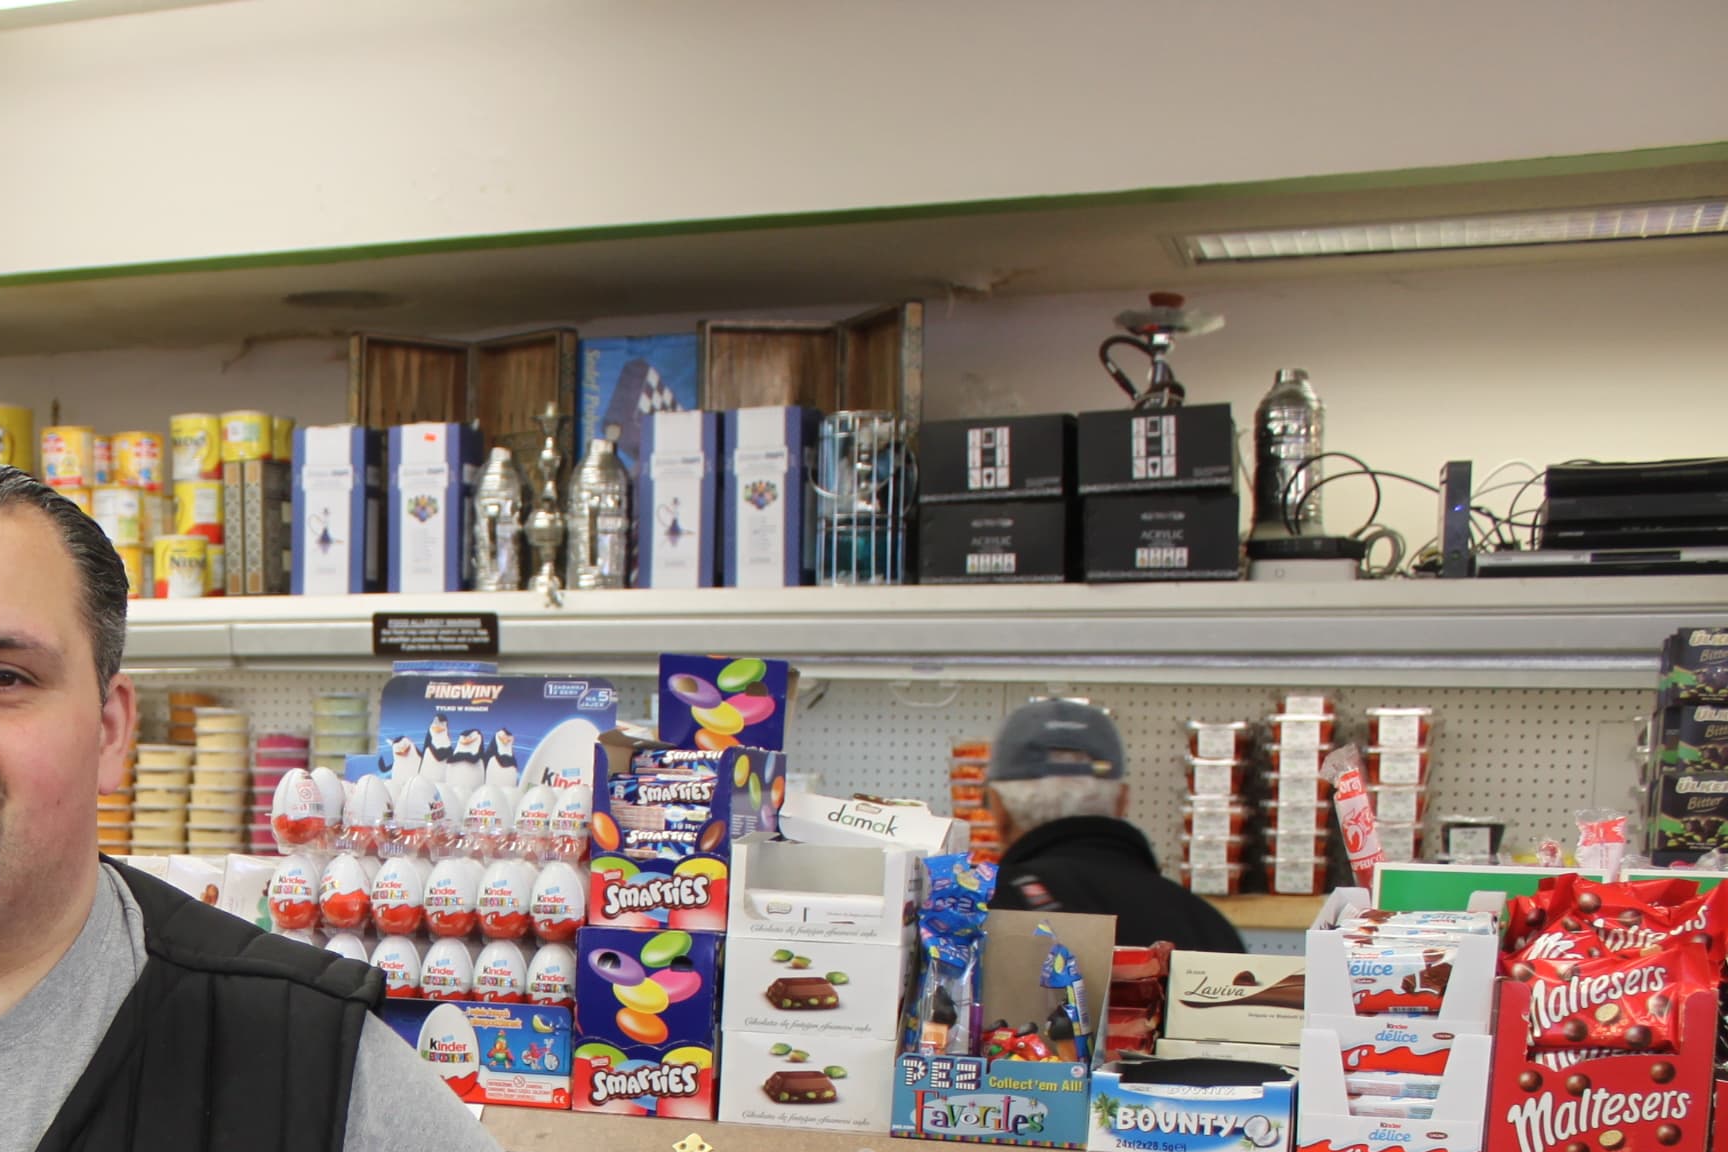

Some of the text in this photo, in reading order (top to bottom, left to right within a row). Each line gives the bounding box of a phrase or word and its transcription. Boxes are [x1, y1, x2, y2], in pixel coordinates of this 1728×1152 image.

[425, 684, 503, 700] PINGWINY
[637, 781, 715, 806] SMARTIES
[828, 804, 898, 837] damak
[604, 877, 709, 916] SMARTIES
[1184, 976, 1246, 1000] Laviva
[1375, 1029, 1419, 1043] délice
[592, 1064, 697, 1102] SMARTIES
[903, 1056, 981, 1090] PEZ
[989, 1076, 1032, 1090] Collect
[1061, 1080, 1083, 1092] All!
[913, 1090, 1045, 1136] Favorites
[1116, 1107, 1240, 1137] BOUNTY
[1368, 1129, 1412, 1143] délice
